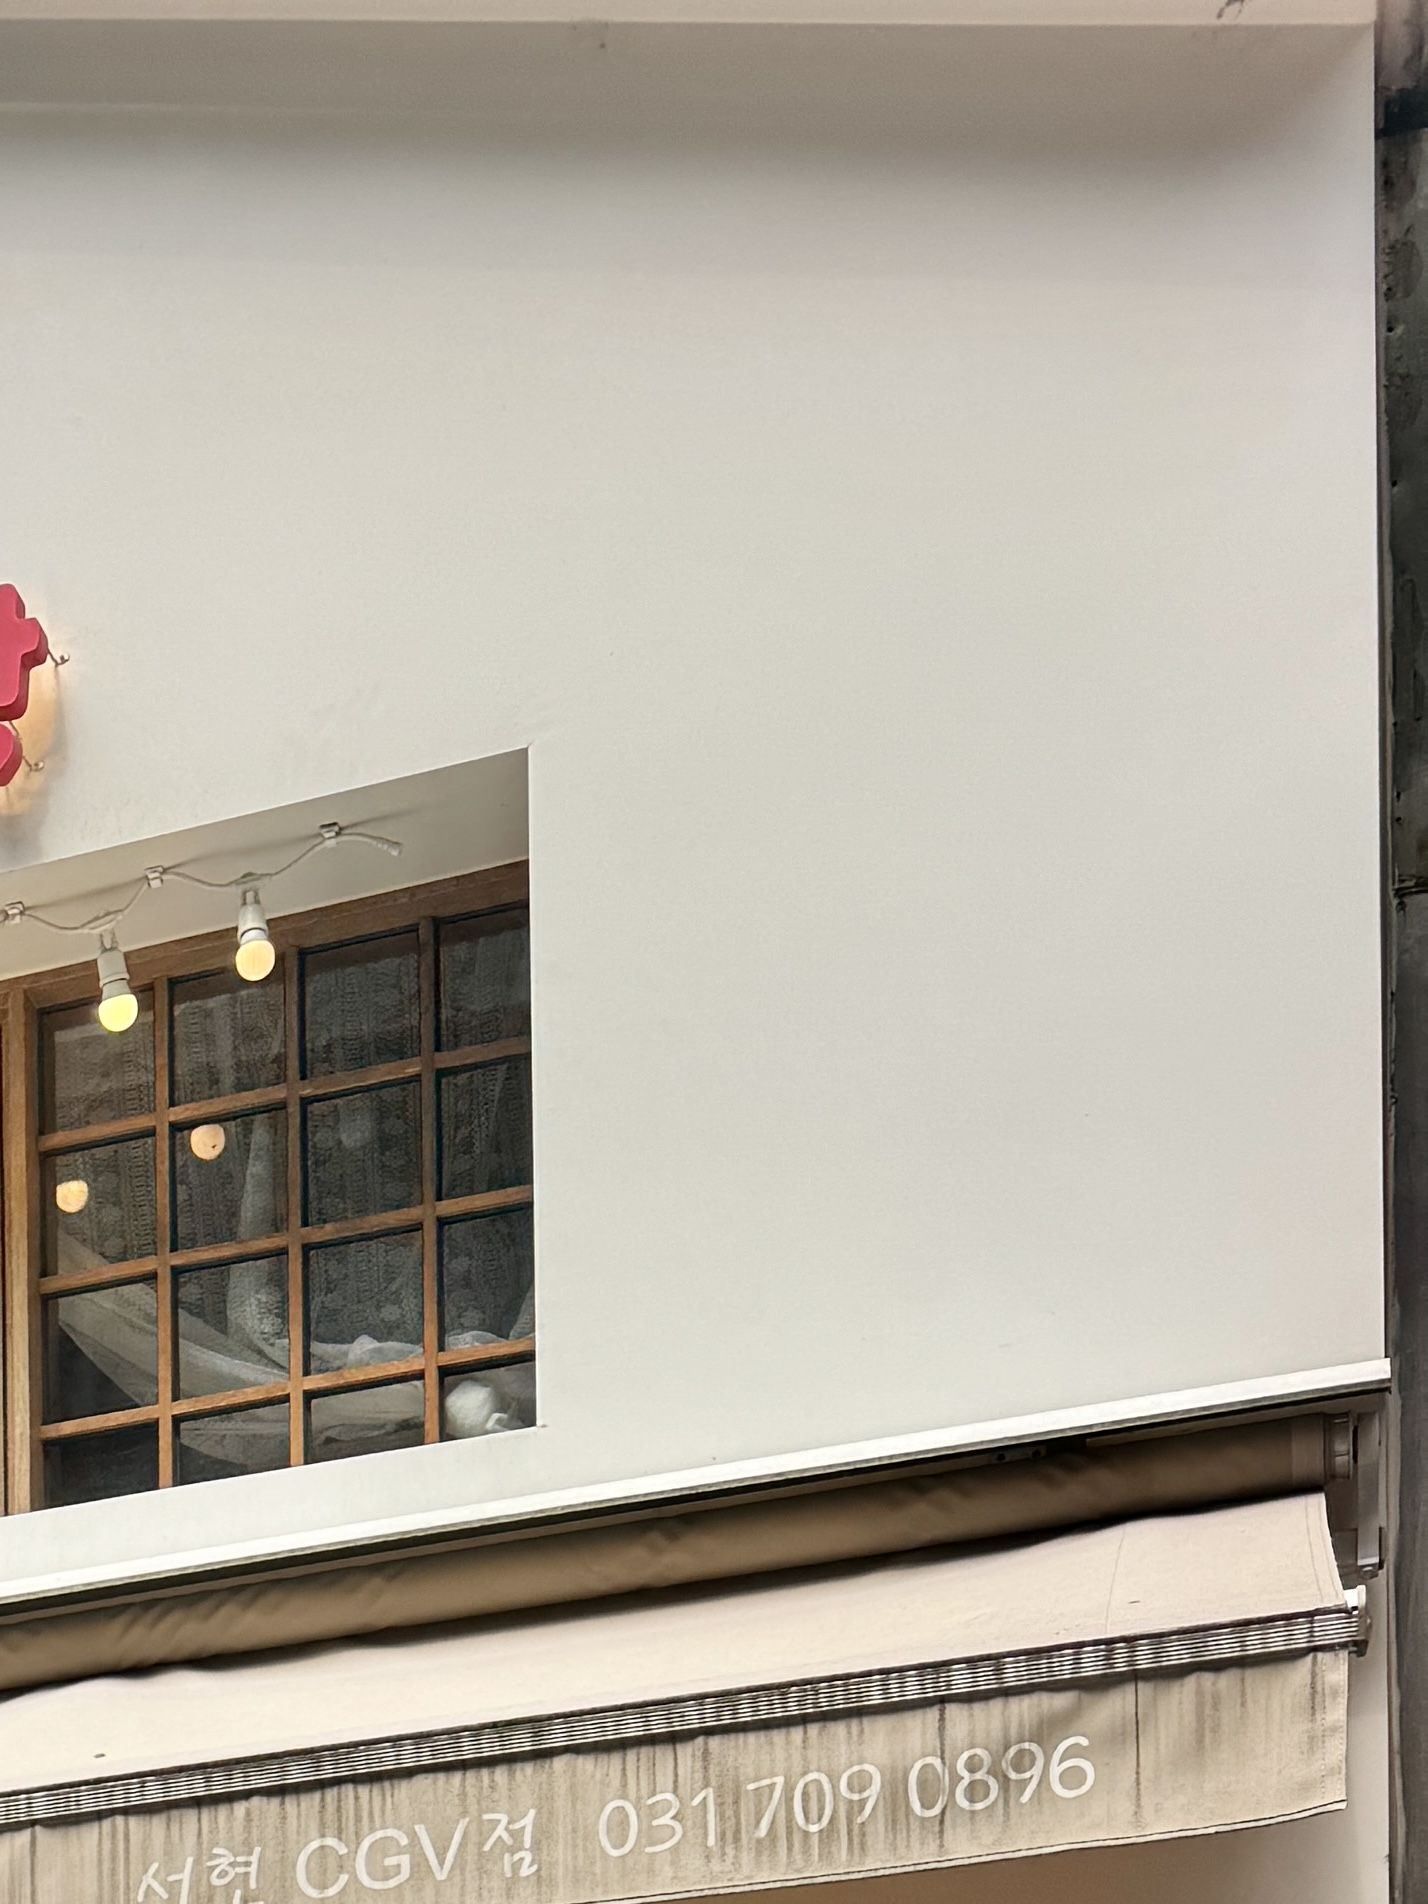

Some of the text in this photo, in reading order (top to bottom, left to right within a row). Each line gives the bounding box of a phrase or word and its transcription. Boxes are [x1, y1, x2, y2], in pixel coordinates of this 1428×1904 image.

[598, 1784, 716, 1859] 031
[749, 1762, 880, 1839] 709
[906, 1736, 1097, 1818] 0896
